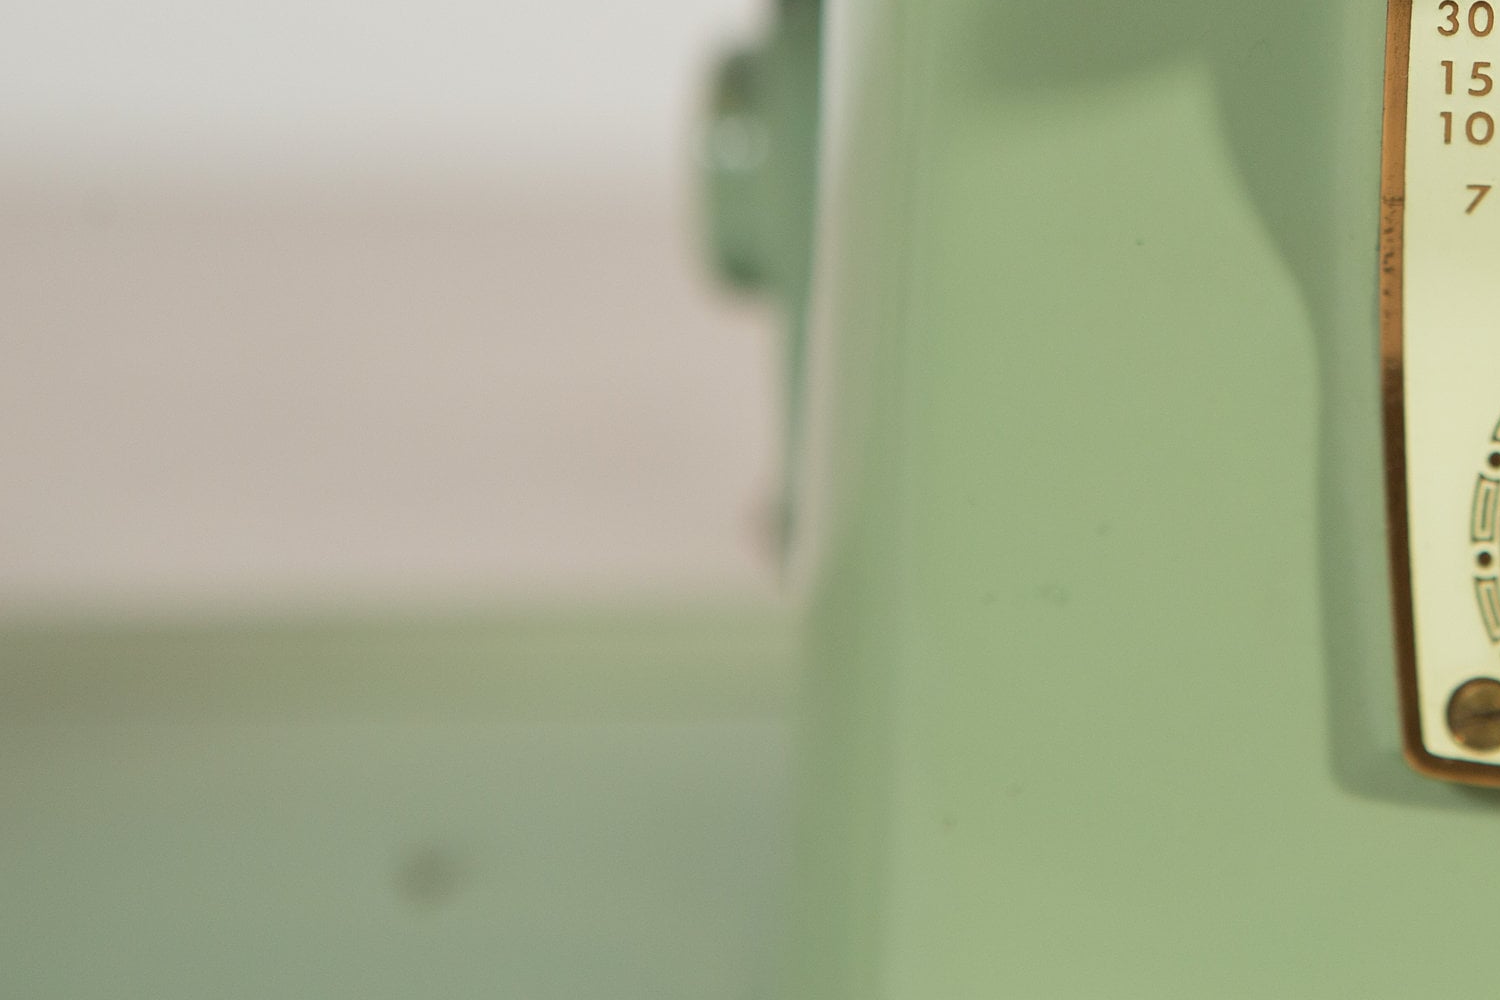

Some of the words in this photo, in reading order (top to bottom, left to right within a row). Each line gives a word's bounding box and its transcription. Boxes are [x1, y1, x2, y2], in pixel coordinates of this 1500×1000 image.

[1437, 0, 1495, 37] 30
[1441, 61, 1494, 97] 15
[1440, 112, 1495, 145] 10
[1465, 185, 1492, 214] 7
